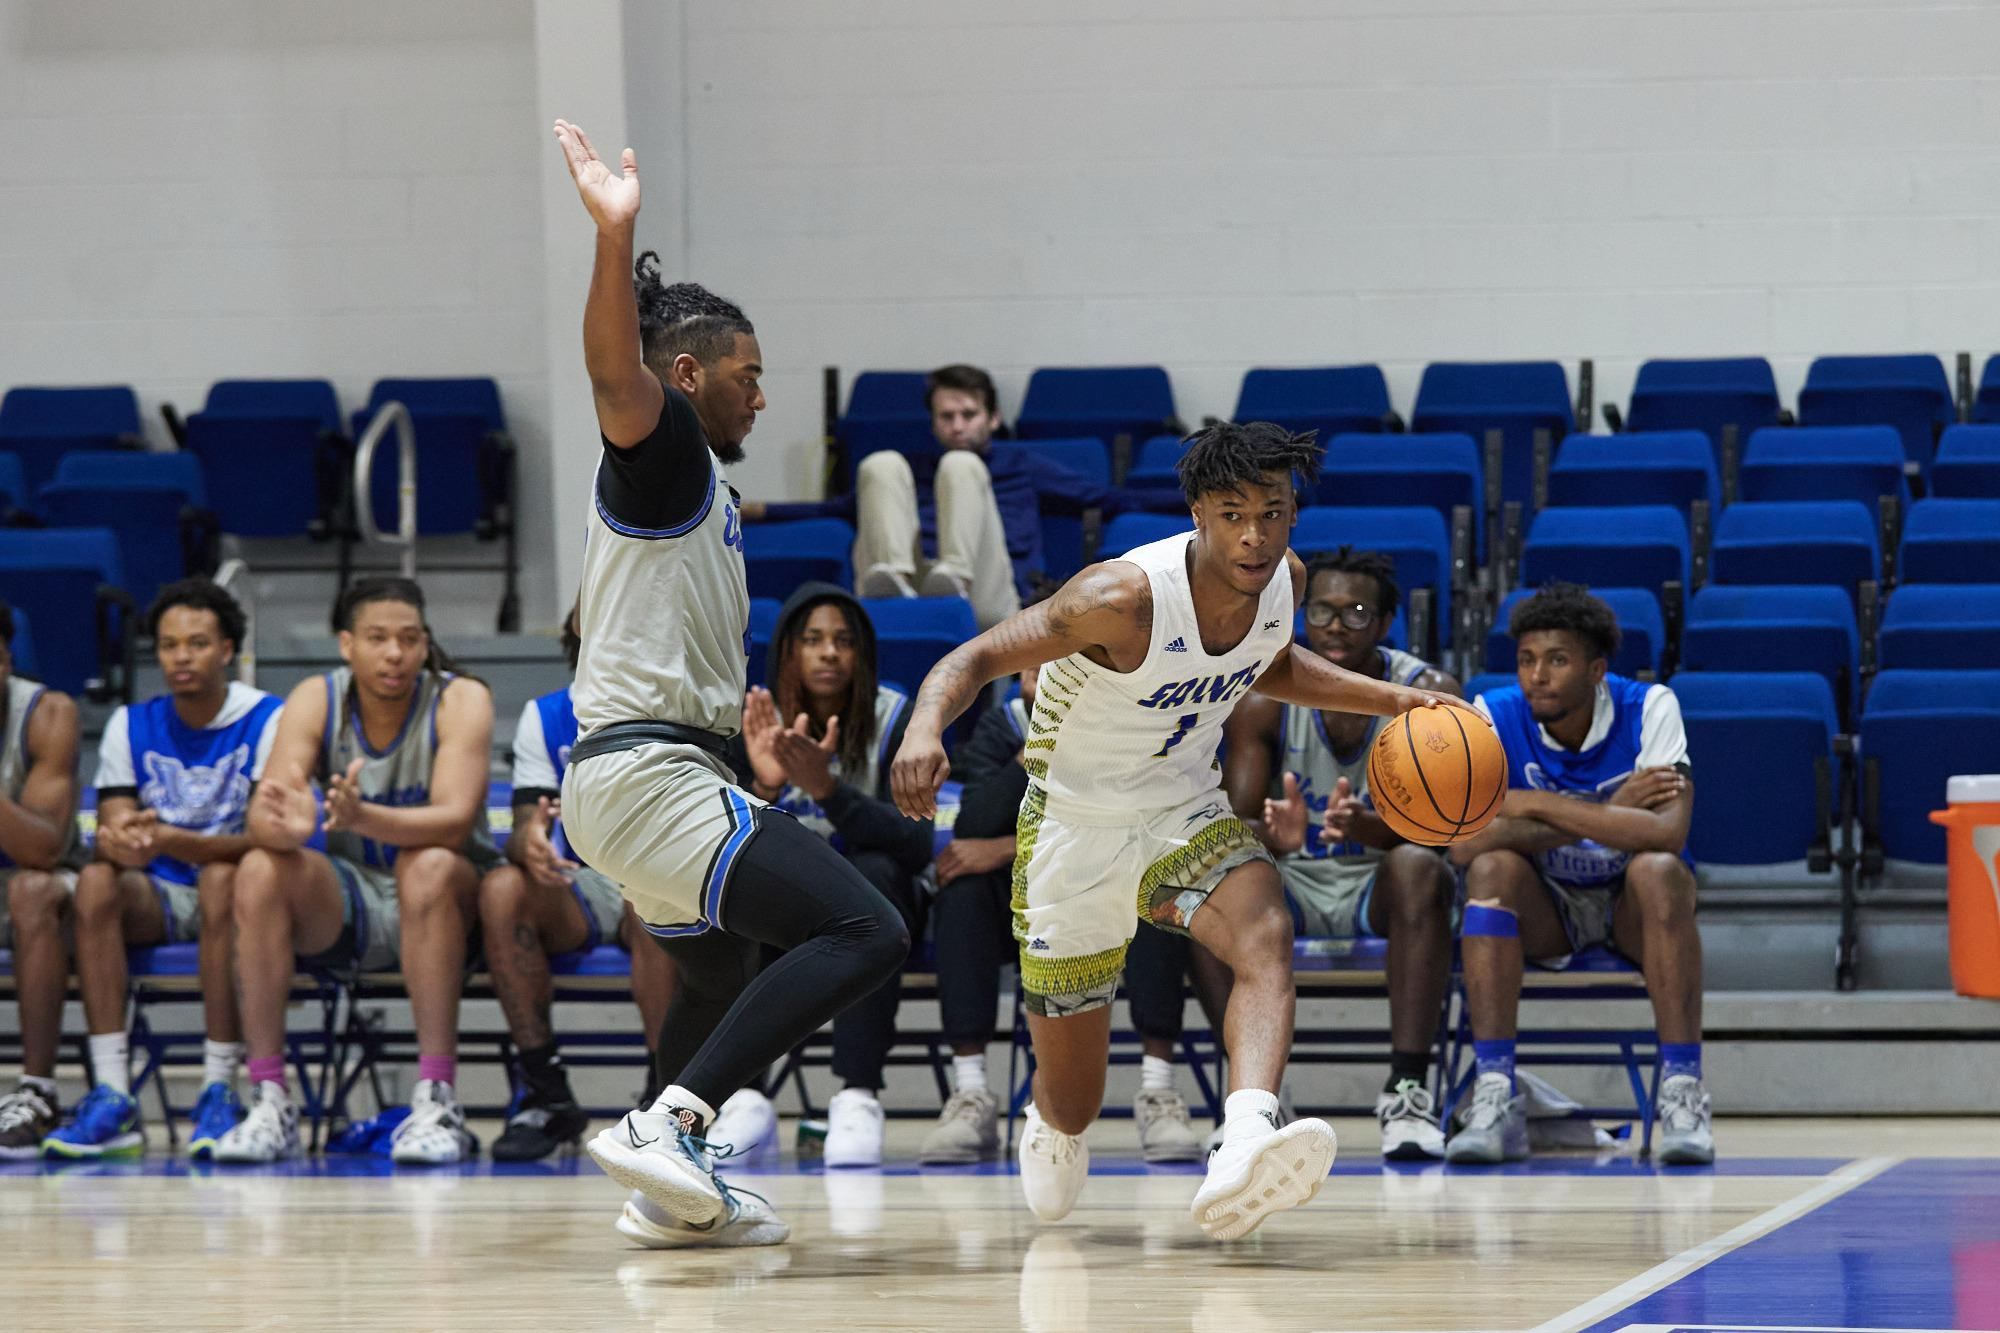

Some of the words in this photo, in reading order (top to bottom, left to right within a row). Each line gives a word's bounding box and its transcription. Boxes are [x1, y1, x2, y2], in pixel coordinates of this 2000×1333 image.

[1263, 619, 1280, 631] SAC
[1164, 645, 1188, 653] adidas
[1136, 658, 1263, 710] SAINTS
[1151, 712, 1200, 758] 1
